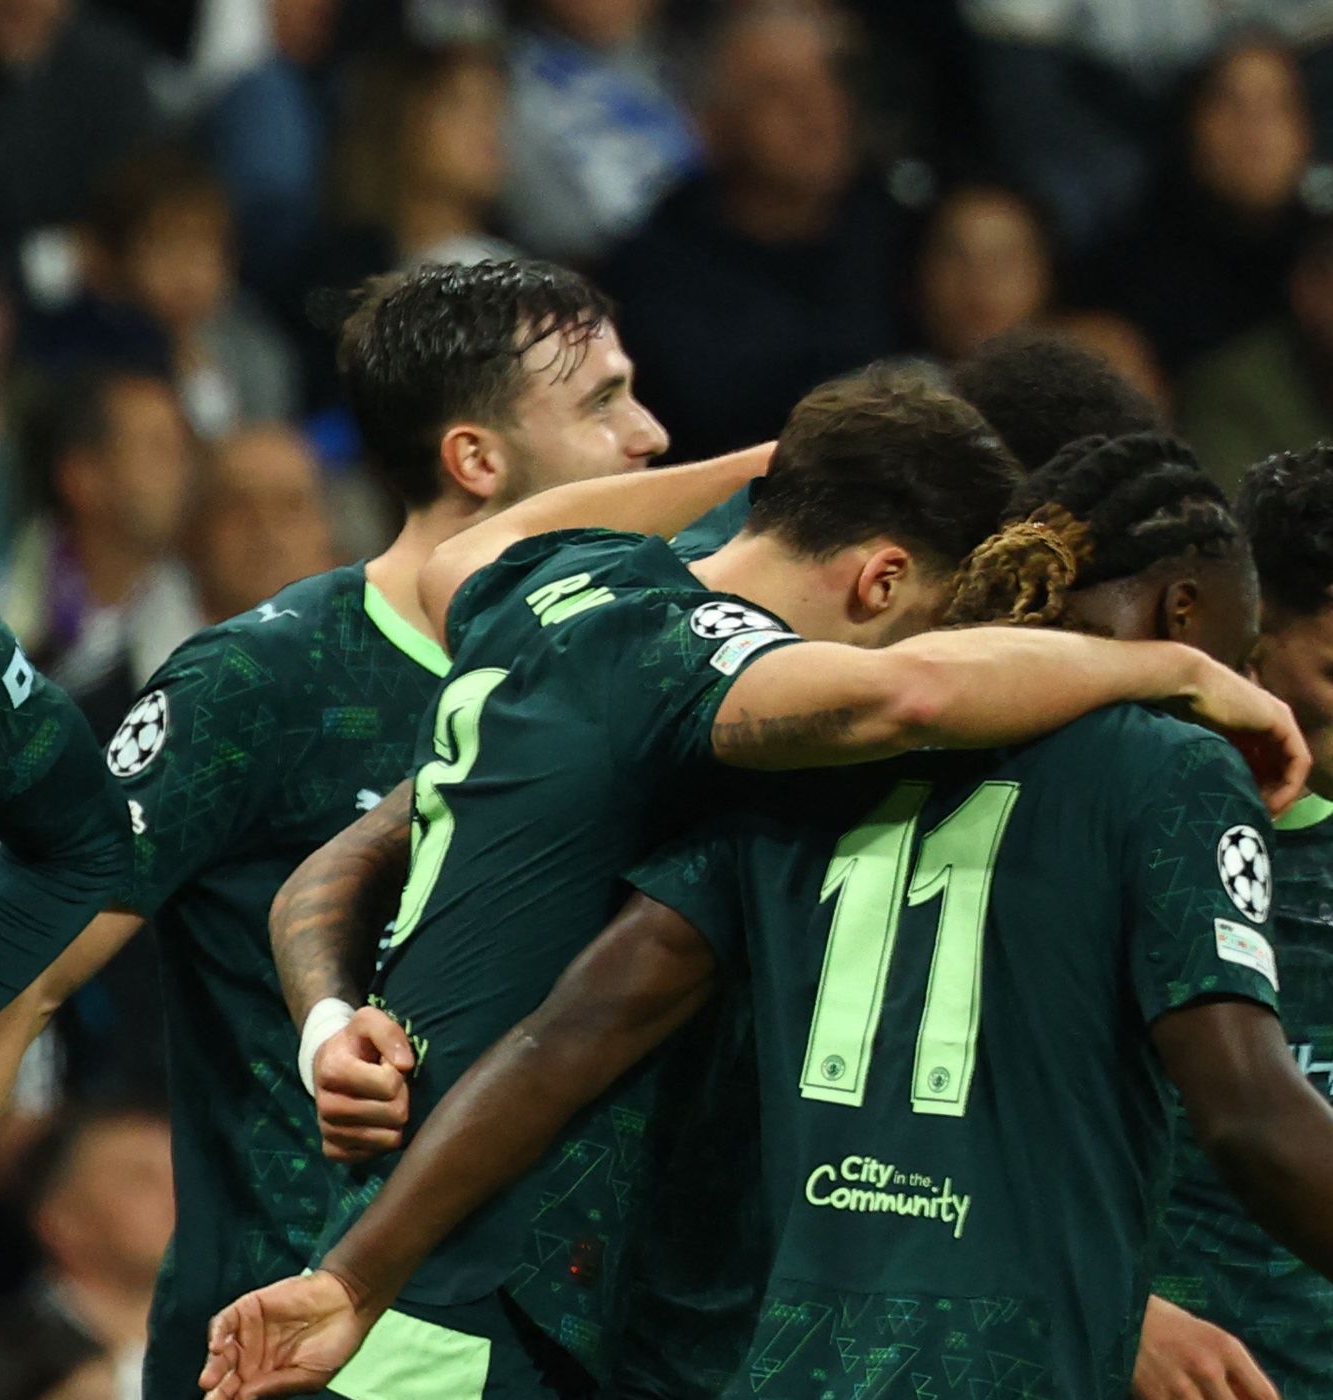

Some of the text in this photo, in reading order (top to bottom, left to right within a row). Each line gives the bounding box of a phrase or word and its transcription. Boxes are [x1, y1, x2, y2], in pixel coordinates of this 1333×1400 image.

[800, 780, 1021, 1117] 11
[805, 1163, 972, 1239] Community
[840, 1155, 932, 1188] City in the
